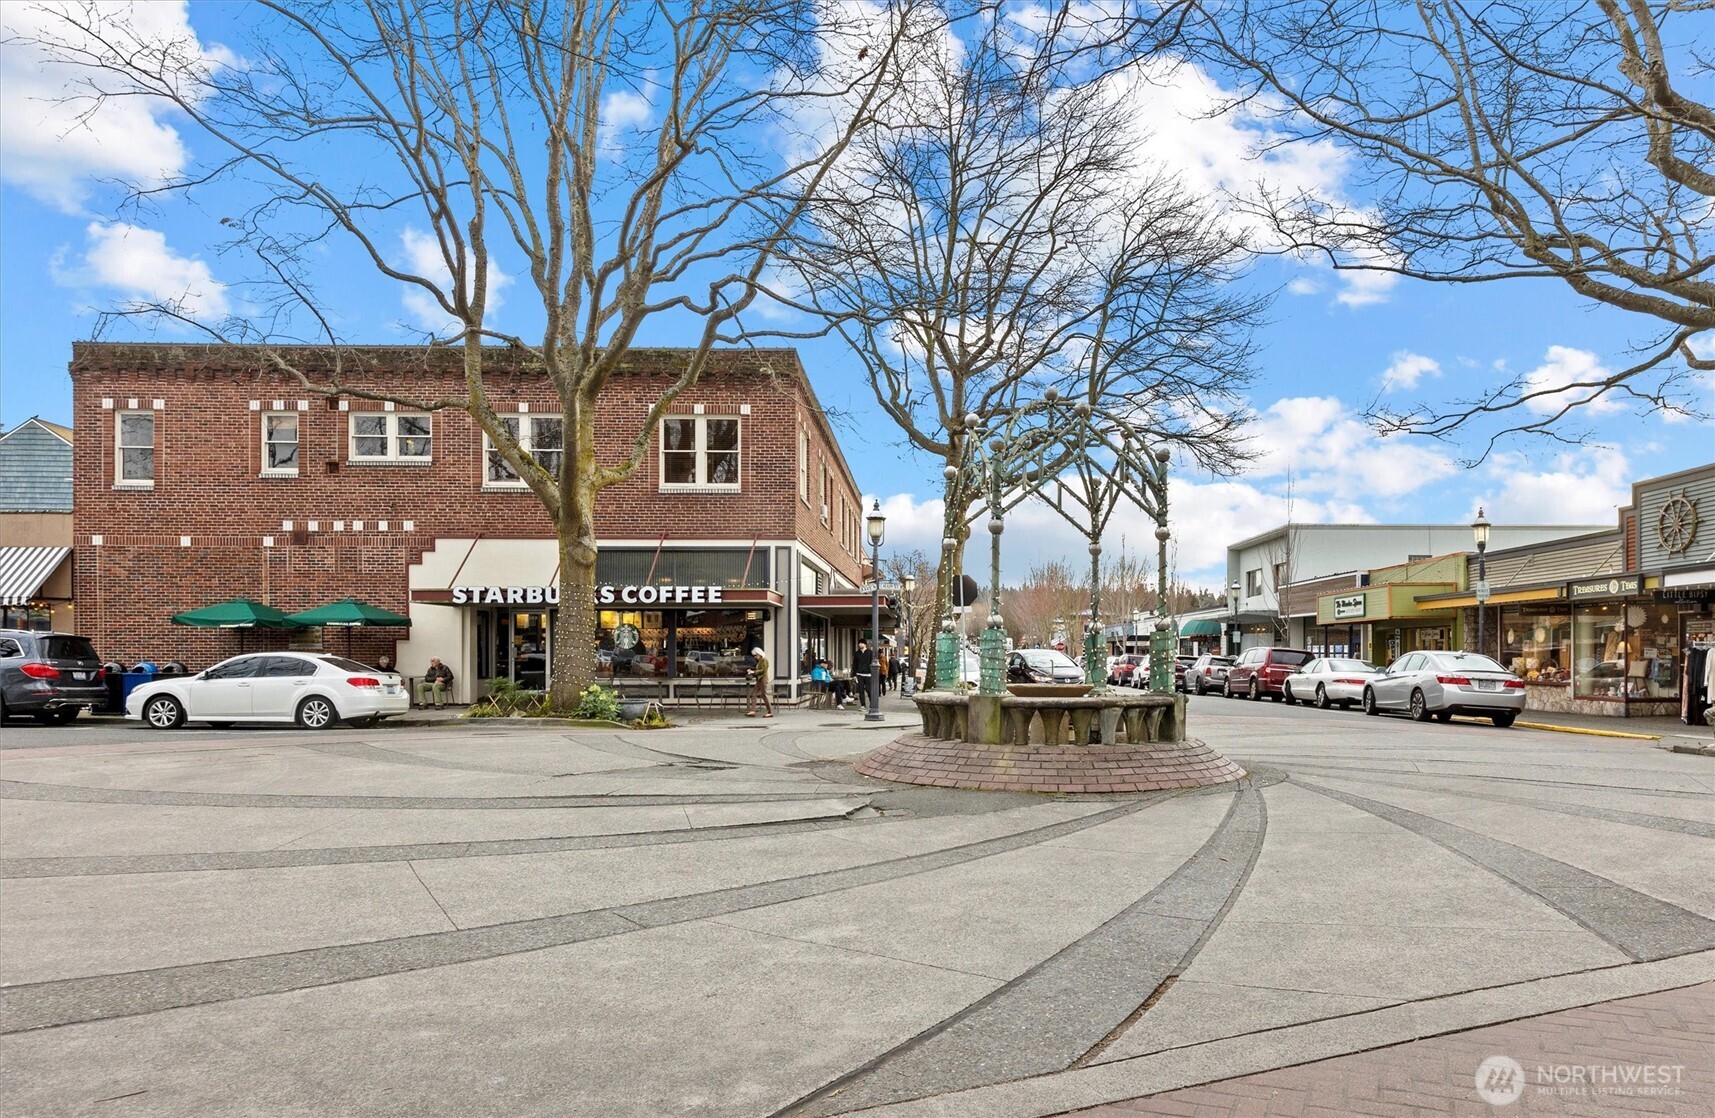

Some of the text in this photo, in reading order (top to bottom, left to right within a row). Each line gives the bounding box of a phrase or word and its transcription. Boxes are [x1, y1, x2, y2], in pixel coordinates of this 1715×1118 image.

[452, 585, 723, 604] STARBUS COFFEE
[1662, 590, 1708, 599] LITTLE BIPSY
